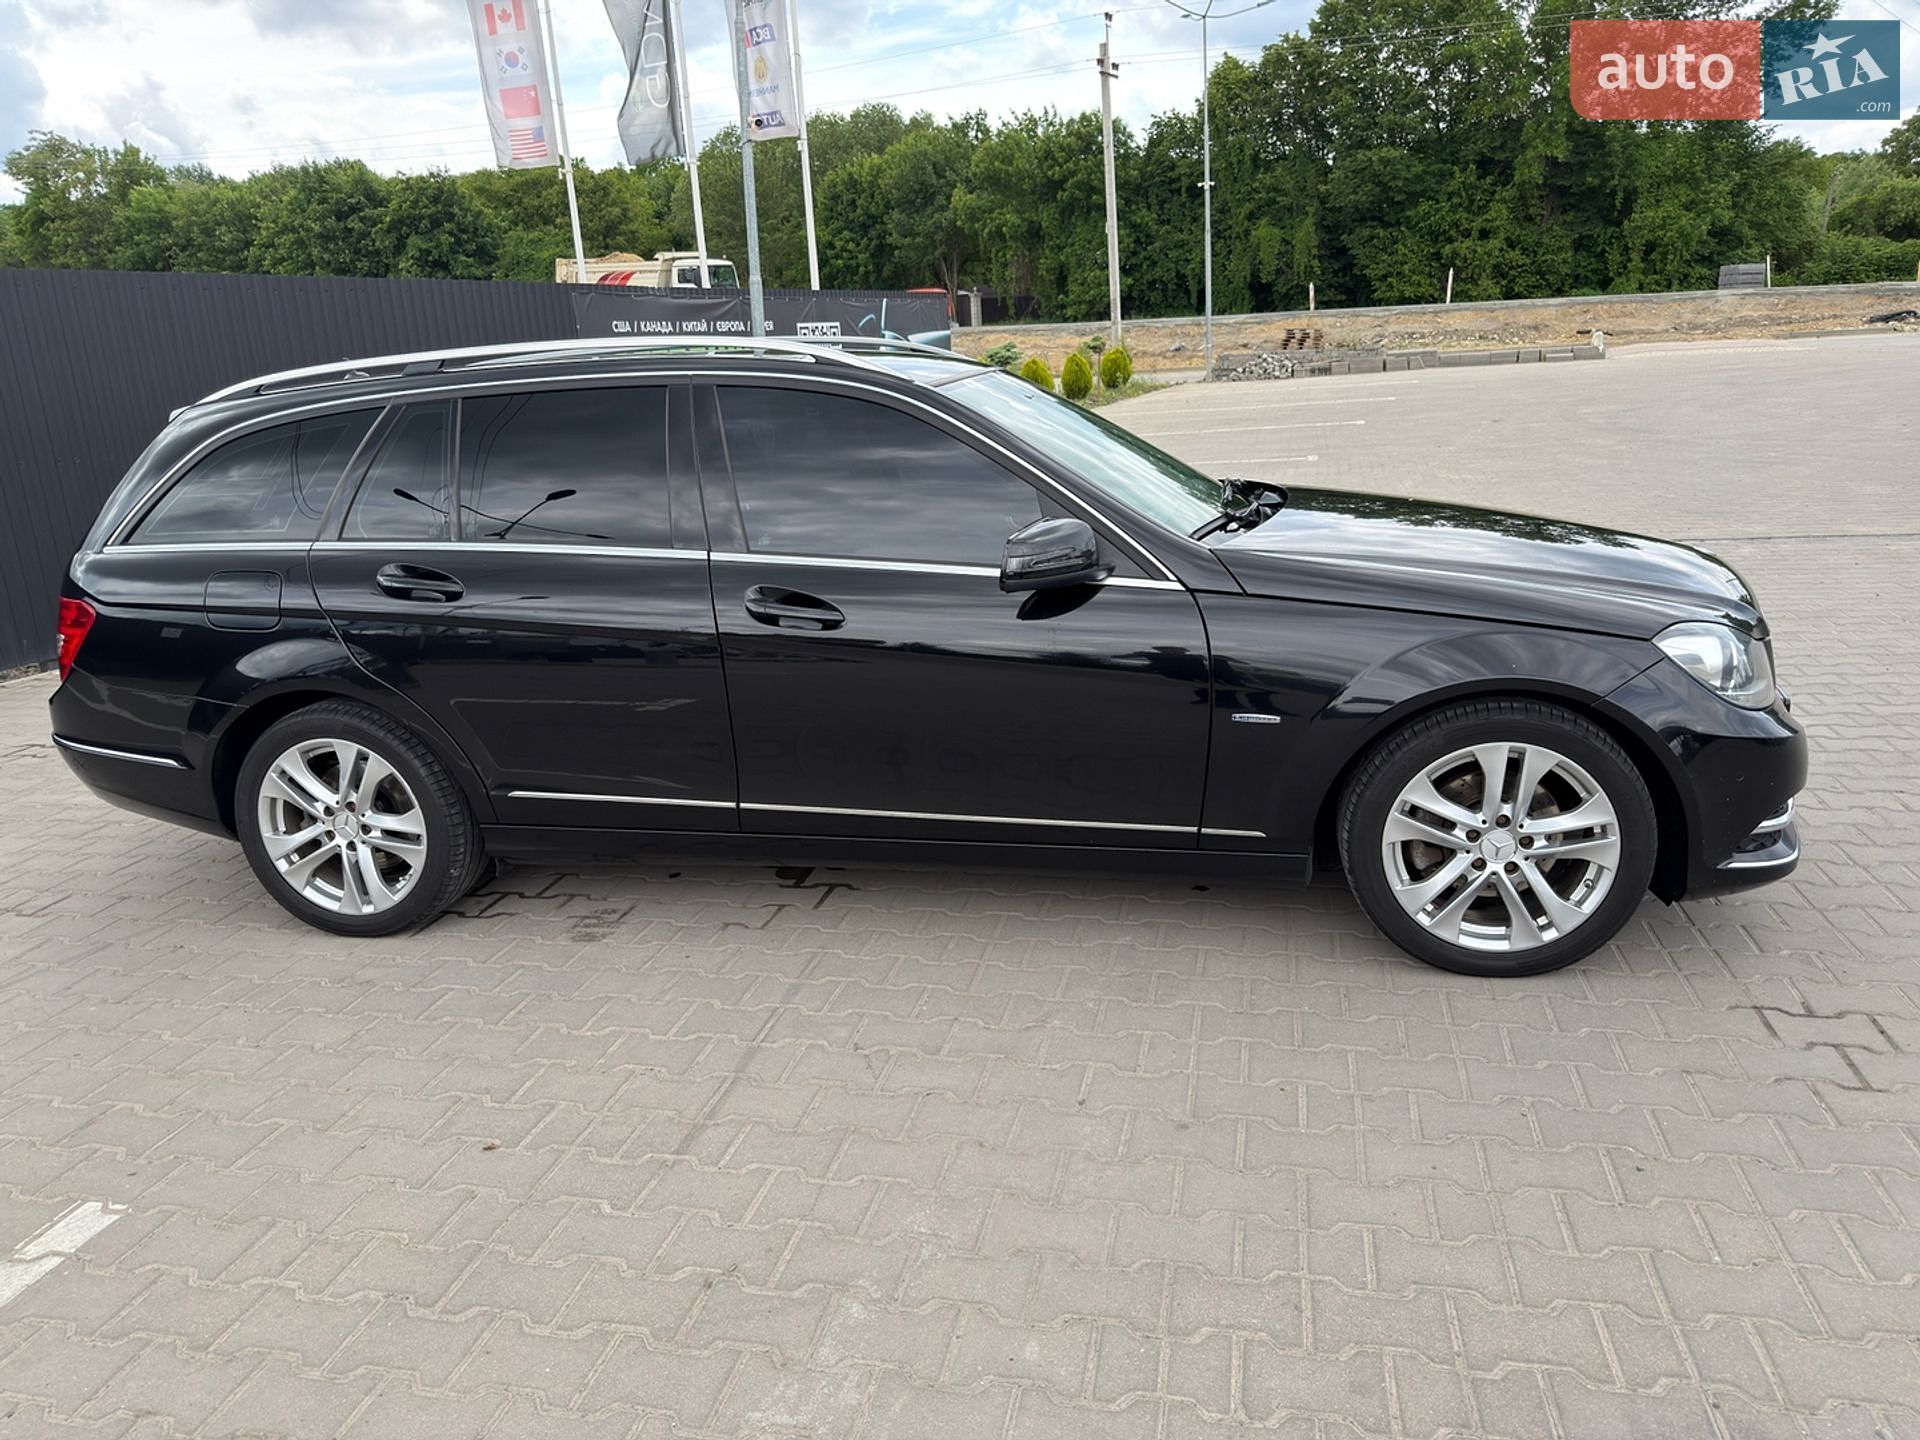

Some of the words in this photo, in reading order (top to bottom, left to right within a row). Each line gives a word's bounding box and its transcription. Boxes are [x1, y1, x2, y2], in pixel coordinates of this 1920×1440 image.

[612, 321, 632, 332] США
[640, 321, 674, 334] КАНАДА
[682, 319, 708, 332] КИТАЙ
